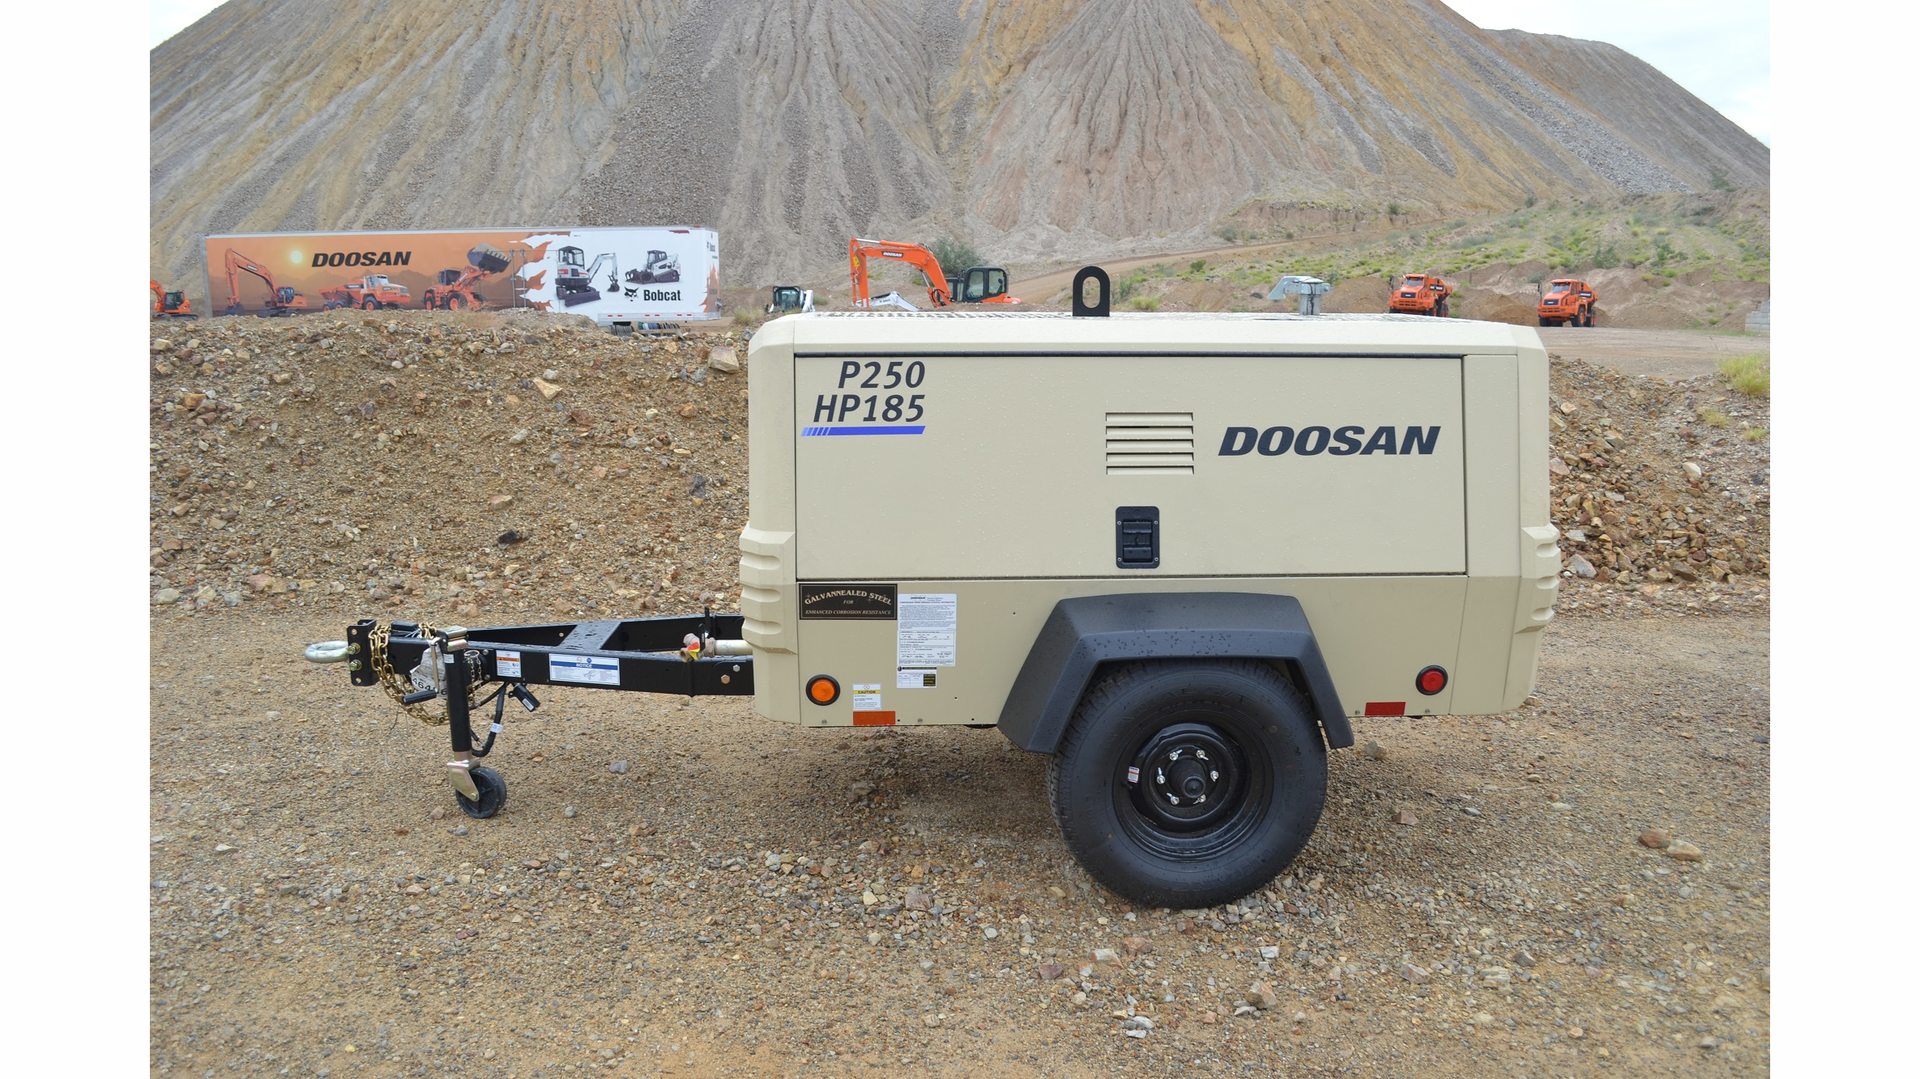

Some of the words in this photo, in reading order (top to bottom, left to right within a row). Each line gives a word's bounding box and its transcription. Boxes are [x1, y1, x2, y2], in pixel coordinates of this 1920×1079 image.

[311, 251, 411, 268] DOOSAN
[643, 289, 681, 301] Bobcat
[838, 361, 925, 389] P250
[813, 394, 925, 422] HP185
[1218, 426, 1441, 456] DOOSAN
[804, 590, 867, 605] GALVANNEALED
[869, 592, 892, 605] STEEL
